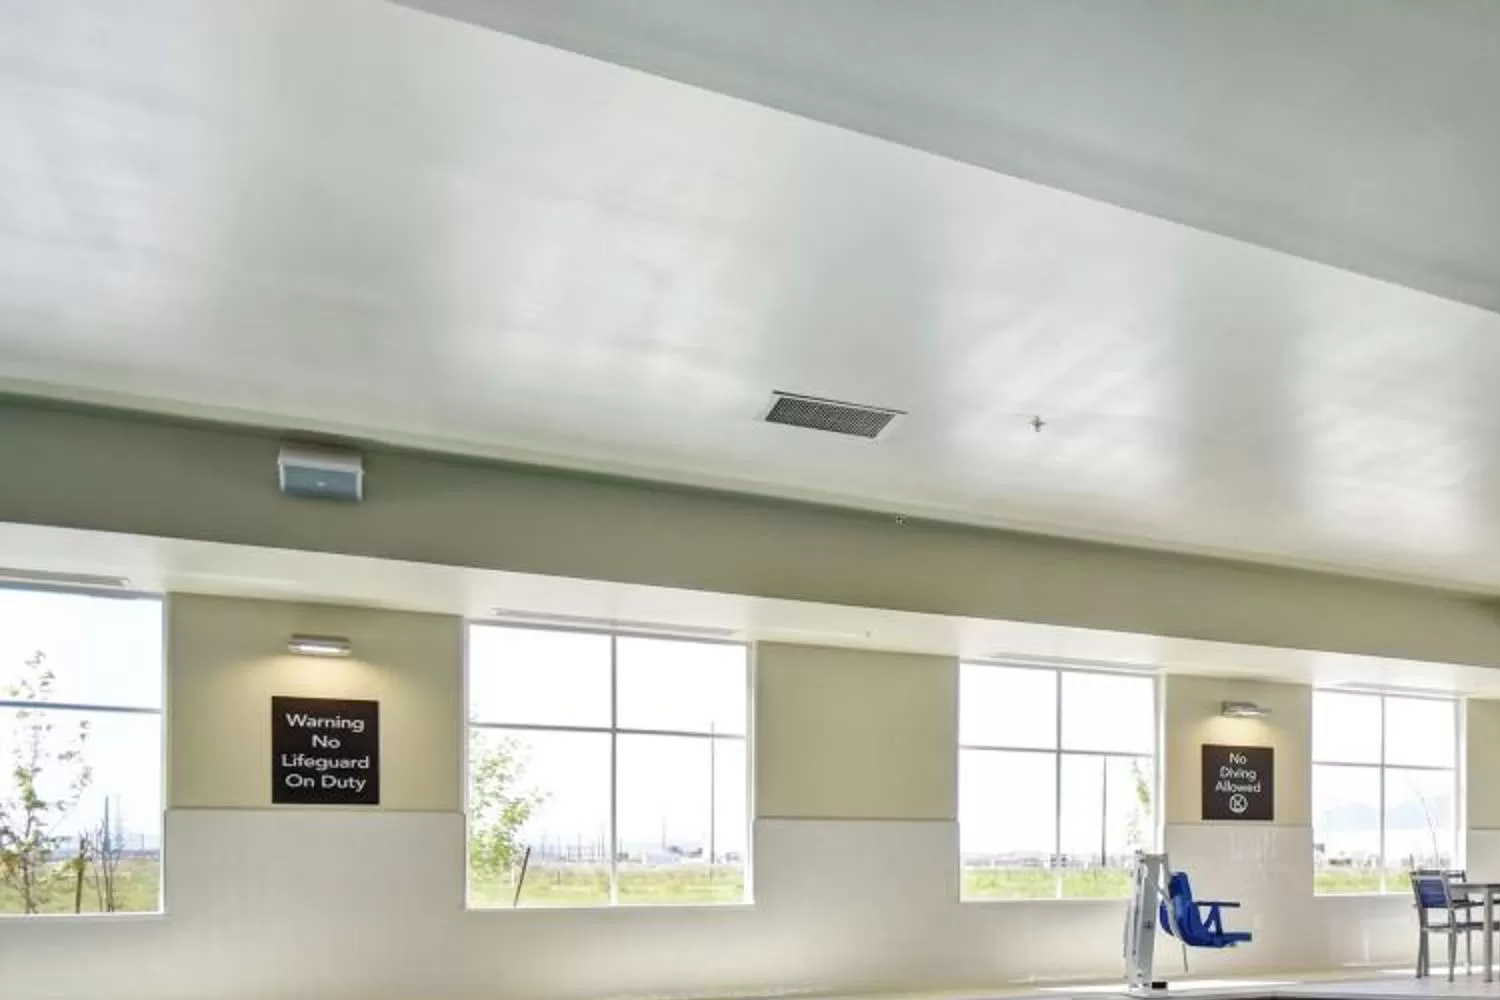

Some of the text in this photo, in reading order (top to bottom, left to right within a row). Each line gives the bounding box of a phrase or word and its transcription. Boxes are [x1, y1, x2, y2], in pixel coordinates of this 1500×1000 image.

[285, 712, 366, 733] Warning
[311, 734, 341, 749] No
[281, 753, 370, 771] Lifeguard
[1228, 752, 1248, 765] No
[1219, 765, 1257, 782] Diving
[285, 773, 367, 793] On Duty
[1215, 780, 1261, 793] Allowed
